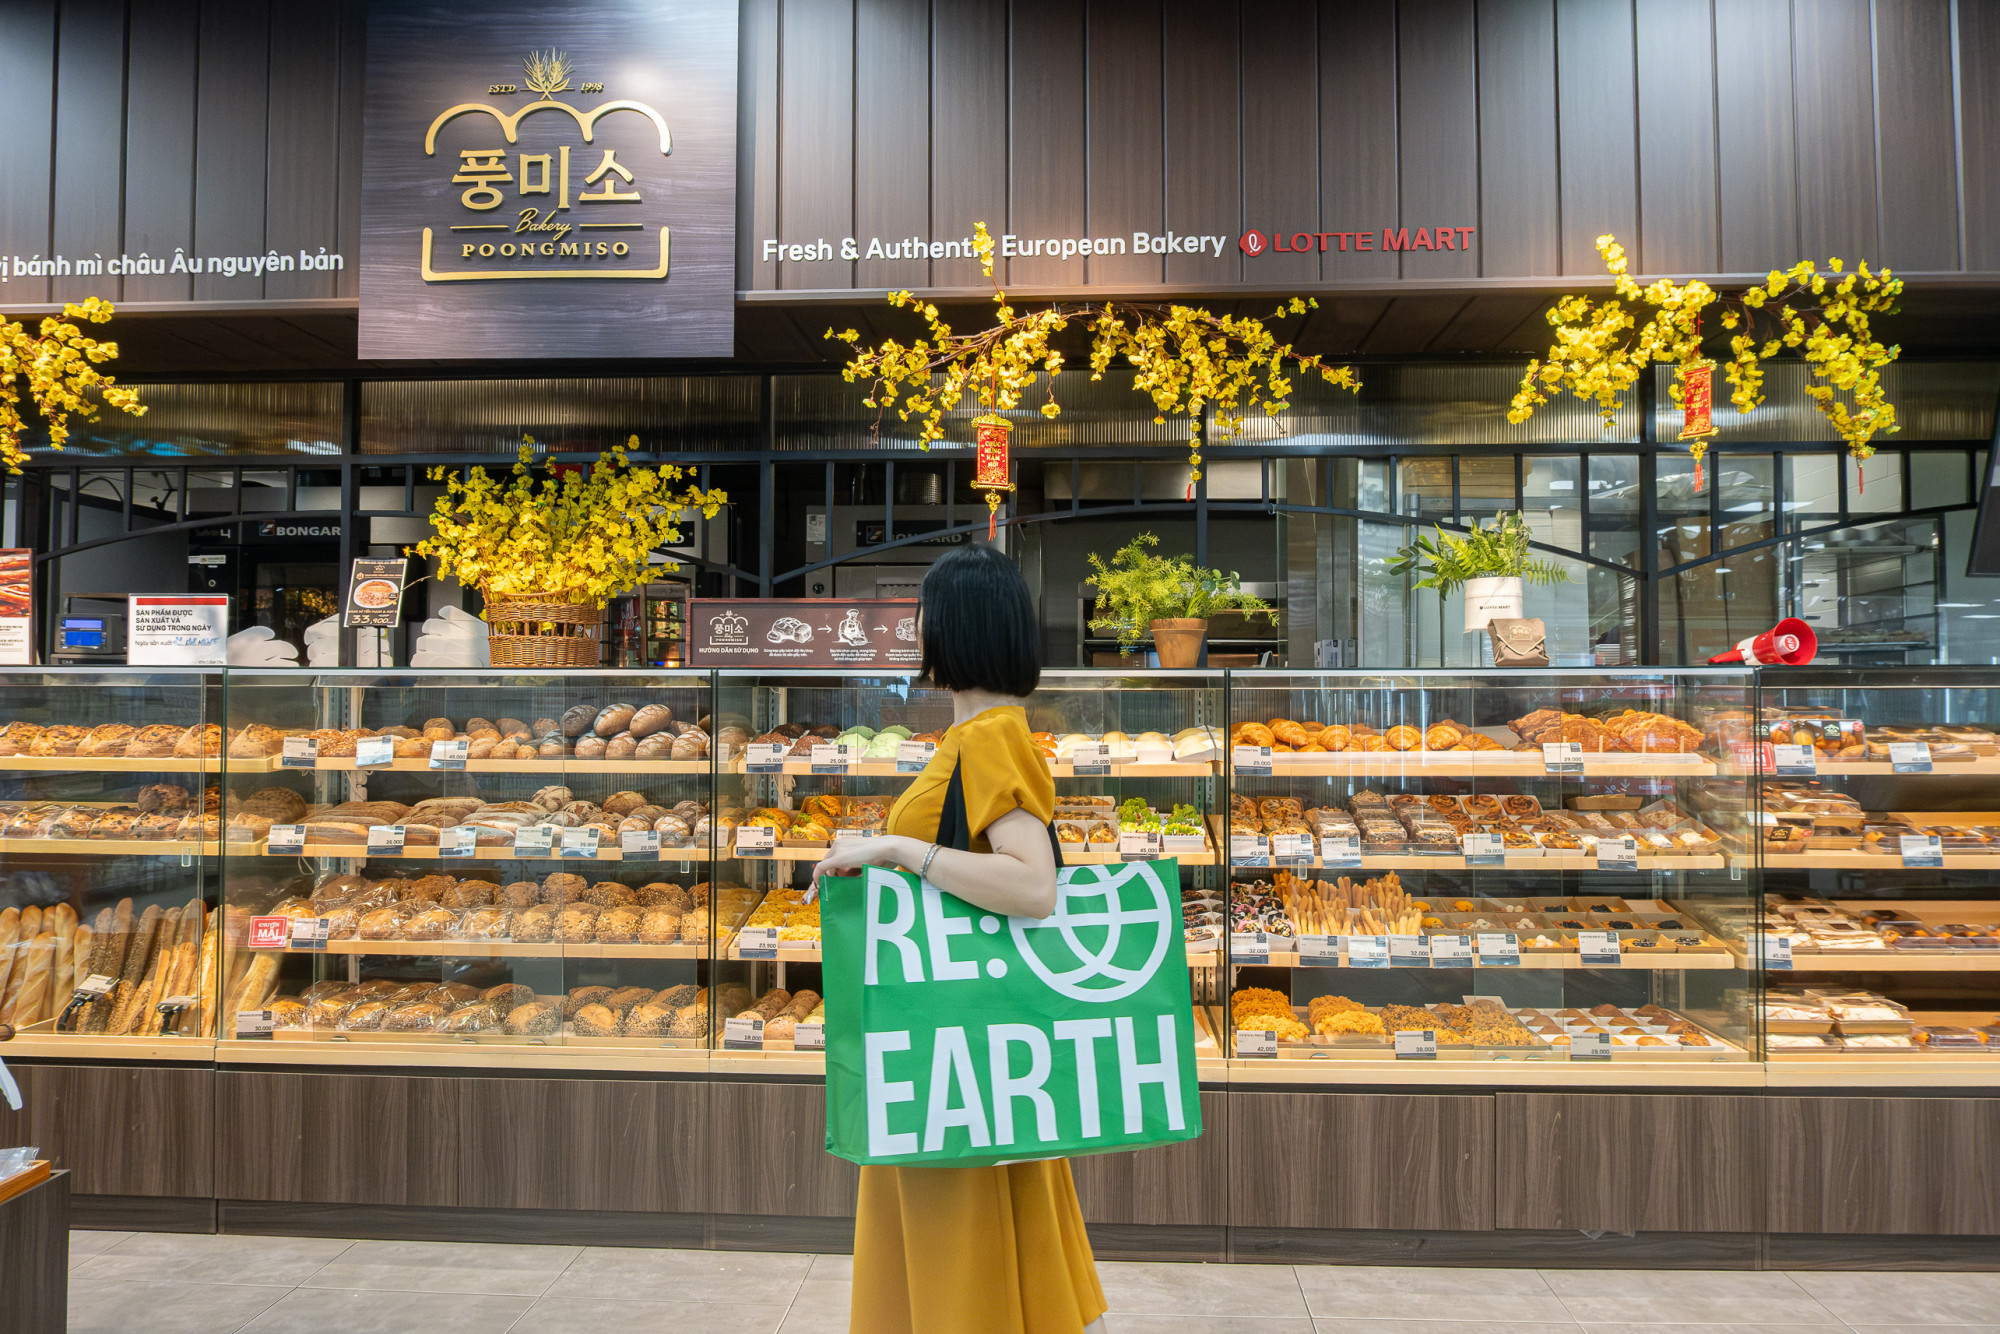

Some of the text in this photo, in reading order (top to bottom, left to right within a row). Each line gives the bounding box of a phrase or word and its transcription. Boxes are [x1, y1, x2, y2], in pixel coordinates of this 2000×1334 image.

[488, 82, 604, 95] ESTD 1998
[451, 145, 643, 211] 풍미소
[515, 207, 572, 241] Bakery
[461, 241, 629, 257] POONGMISO
[763, 231, 1226, 262] Fresh & Authent European Bakery
[1274, 227, 1475, 252] LOTTE MART
[13, 254, 71, 277] bánh
[76, 252, 102, 275] mì
[107, 252, 165, 275] châu
[169, 247, 203, 274] Âu
[207, 250, 294, 277] nguyên
[300, 247, 344, 272] bản
[277, 526, 341, 536] BONGAR
[172, 609, 192, 618] ĐƯỢC
[146, 625, 166, 633] DỤNG
[714, 624, 744, 634] 풍미소
[864, 866, 1008, 986] RE:
[864, 1013, 1186, 1157] EARTH
